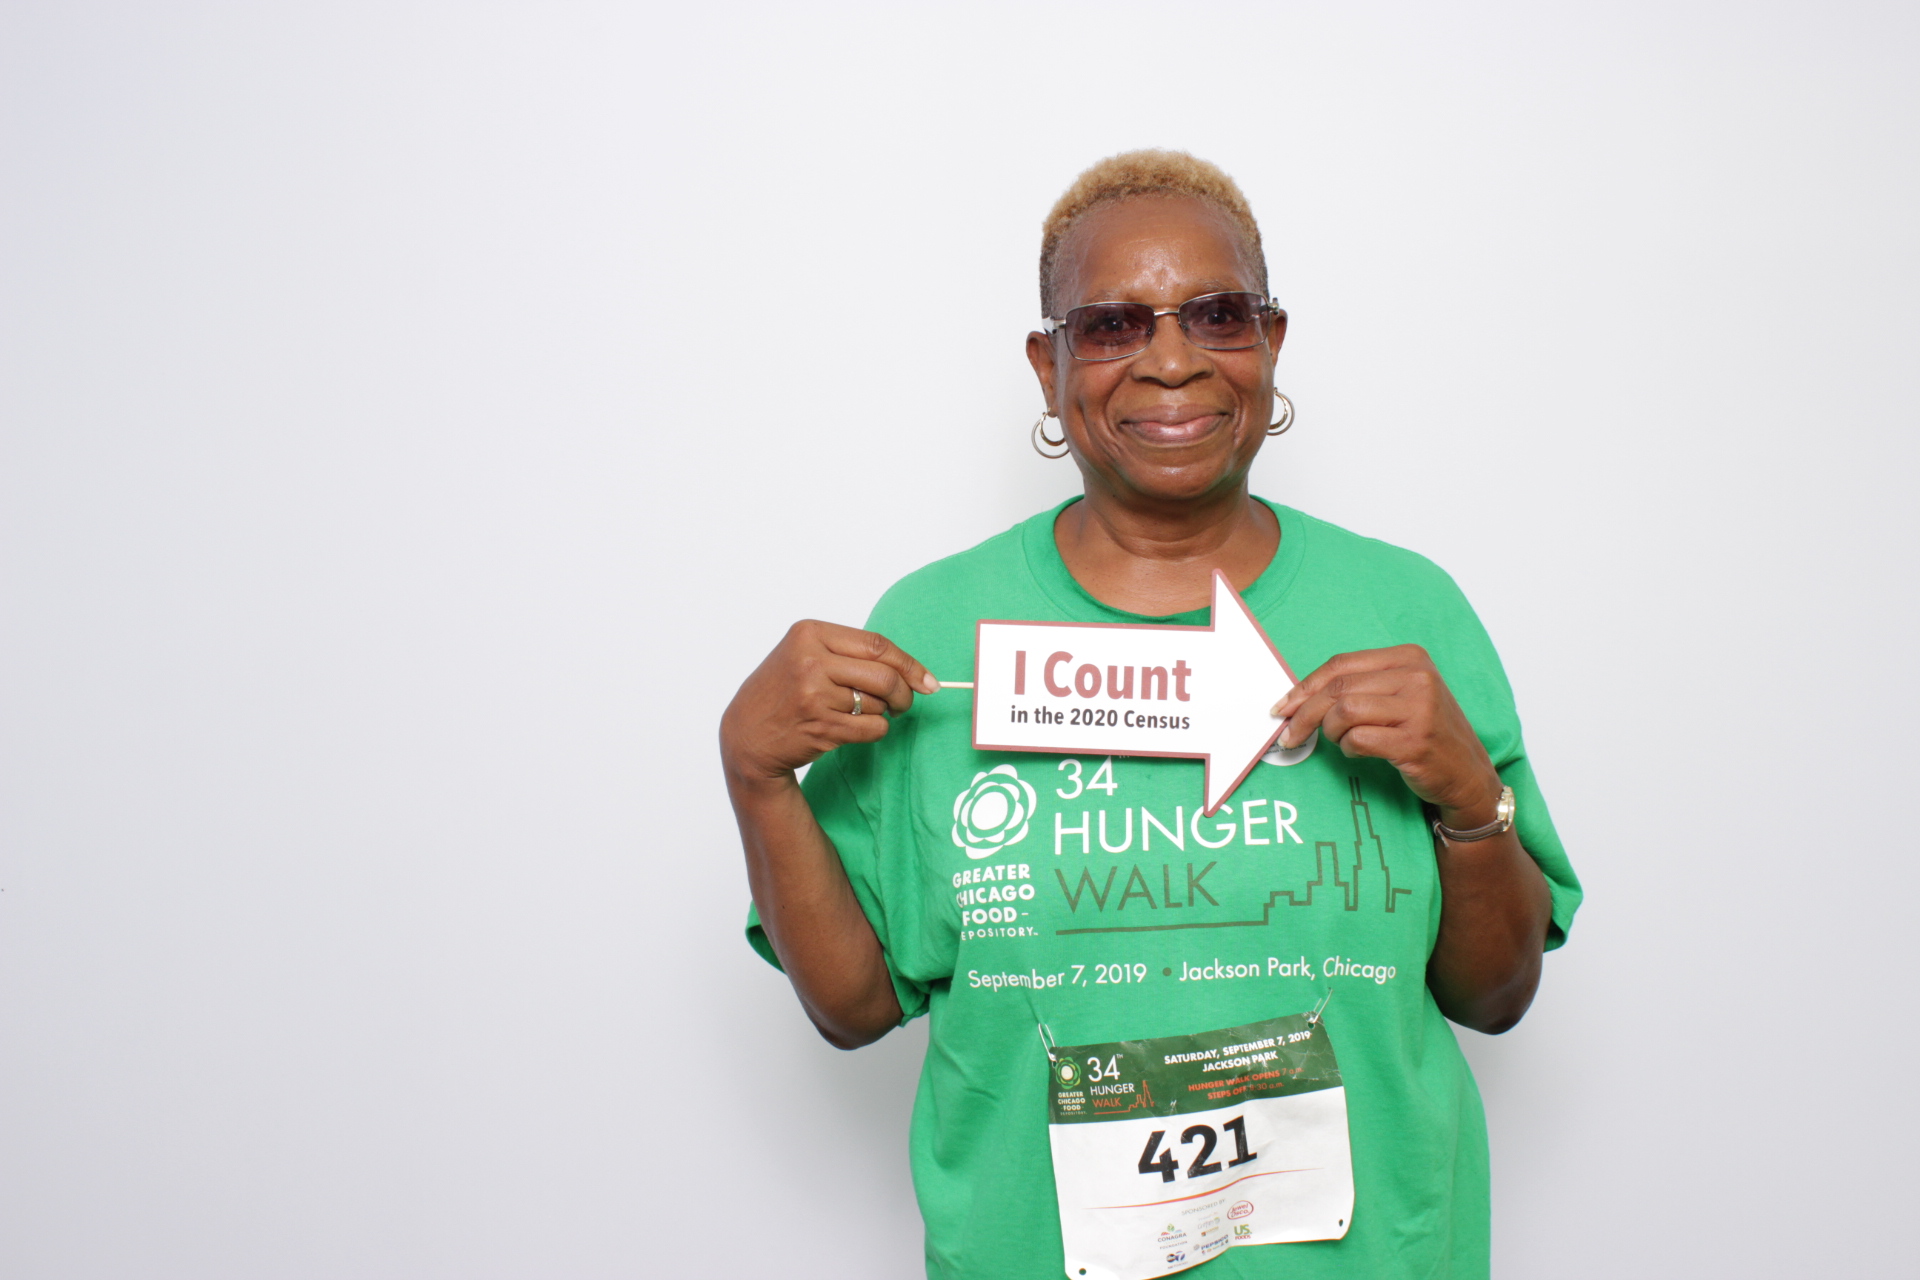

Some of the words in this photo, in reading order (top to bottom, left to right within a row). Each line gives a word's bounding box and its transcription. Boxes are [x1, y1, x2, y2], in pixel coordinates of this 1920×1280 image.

[1014, 650, 1026, 695] I
[1043, 651, 1192, 702] Count
[1010, 705, 1028, 724] in
[1034, 706, 1064, 725] the
[1070, 708, 1118, 727] 2020
[1124, 710, 1190, 730] Census
[1056, 754, 1118, 799] 34
[1054, 799, 1304, 855] HUNGER
[952, 863, 1030, 888] GREATER
[1054, 861, 1220, 914] WALK
[962, 906, 1017, 926] FOOD
[960, 926, 1034, 941] EPOSITORY
[967, 968, 1065, 992] September
[1071, 964, 1087, 988] 7,
[1095, 963, 1147, 984] 2019
[1179, 958, 1260, 982] Jackson
[1267, 955, 1315, 981] Park,
[1323, 955, 1396, 985] Chicago
[1164, 1049, 1220, 1065] SATURDAY,
[1223, 1038, 1276, 1056] SEPTEMBER
[1276, 1036, 1286, 1046] 7,
[1287, 1030, 1311, 1043] 2019
[1087, 1055, 1120, 1082] 34
[1202, 1056, 1251, 1072] JACKSON
[1251, 1050, 1278, 1064] PARK
[1090, 1082, 1135, 1096] HUNGER
[1187, 1080, 1225, 1092] HUNGER
[1226, 1075, 1250, 1086] WALK
[1252, 1069, 1281, 1081] OPENS
[1207, 1090, 1231, 1100] STEPS
[1232, 1085, 1247, 1095] OFF
[1057, 1097, 1086, 1105] CHICAGO
[1092, 1097, 1122, 1108] WALK
[1137, 1114, 1258, 1184] 421
[1157, 1232, 1187, 1242] CONAGRA
